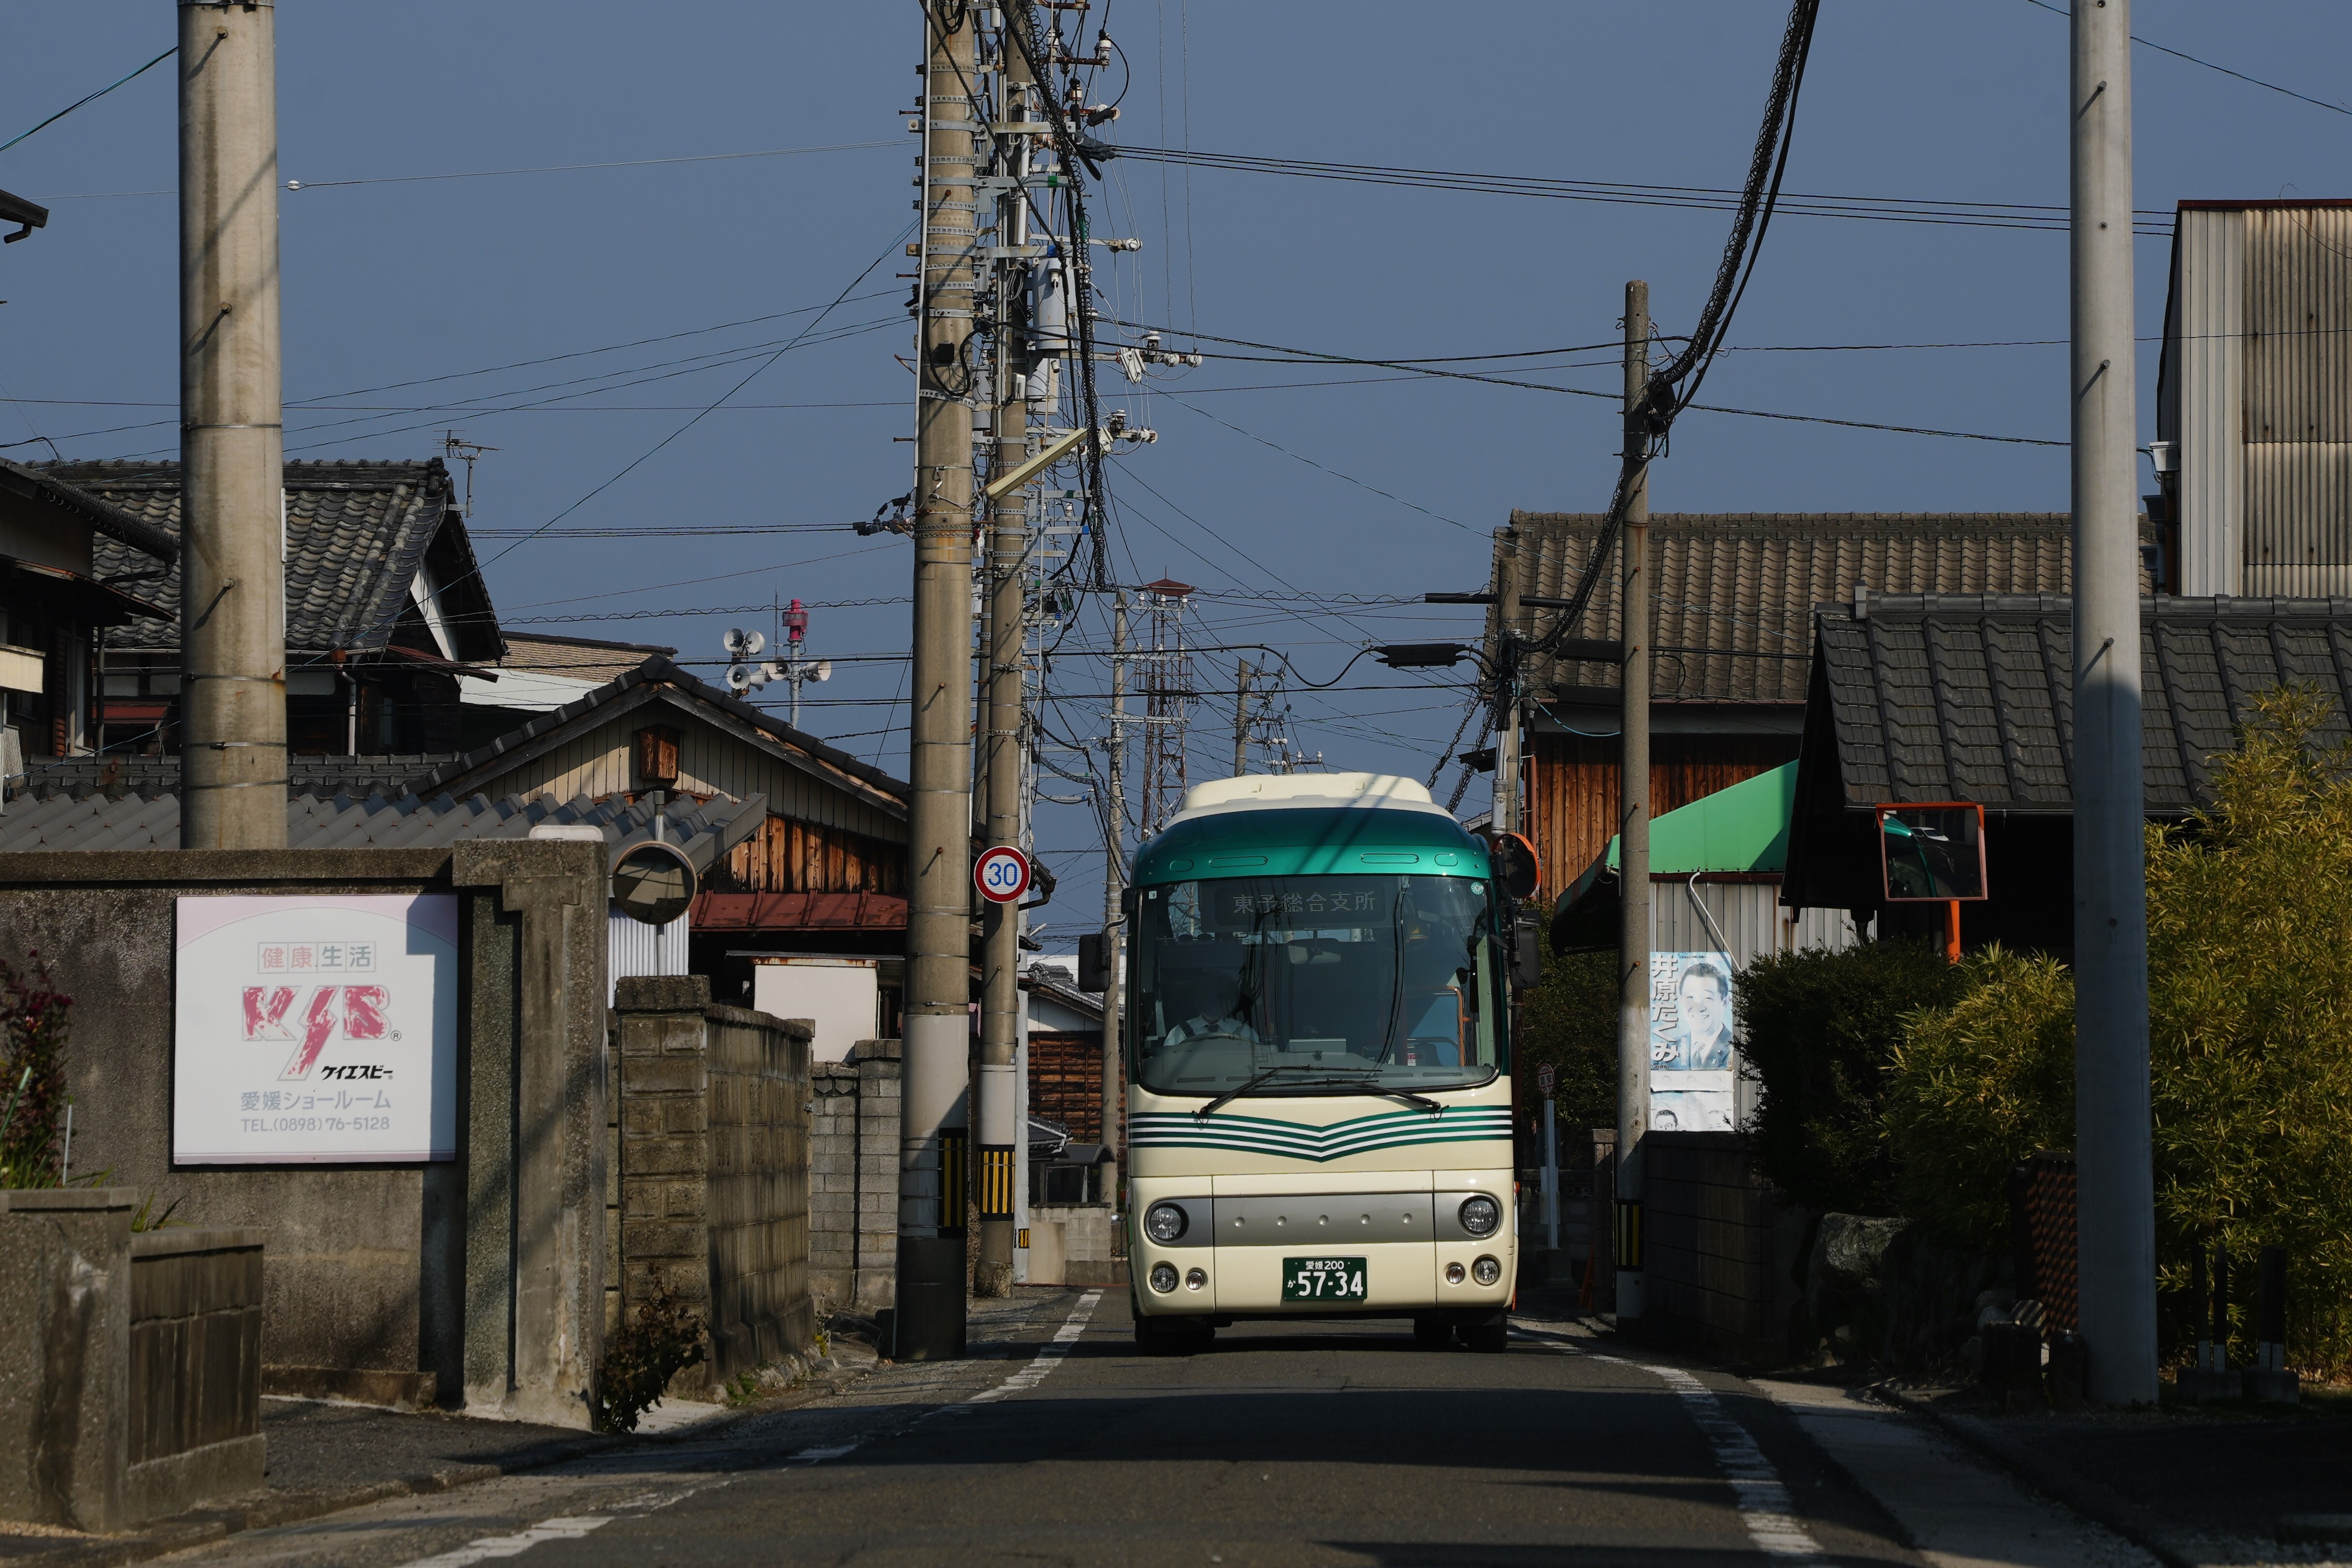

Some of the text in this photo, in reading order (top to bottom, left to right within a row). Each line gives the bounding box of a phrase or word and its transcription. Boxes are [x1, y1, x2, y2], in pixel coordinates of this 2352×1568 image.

[988, 863, 1017, 886] 30
[261, 945, 371, 969] 健康生活
[1652, 954, 1679, 1063] 井原たくみ
[321, 1065, 394, 1081] ケイエスビー
[241, 1090, 392, 1111] 愛媛ショールーム
[1298, 1271, 1364, 1296] 57-34
